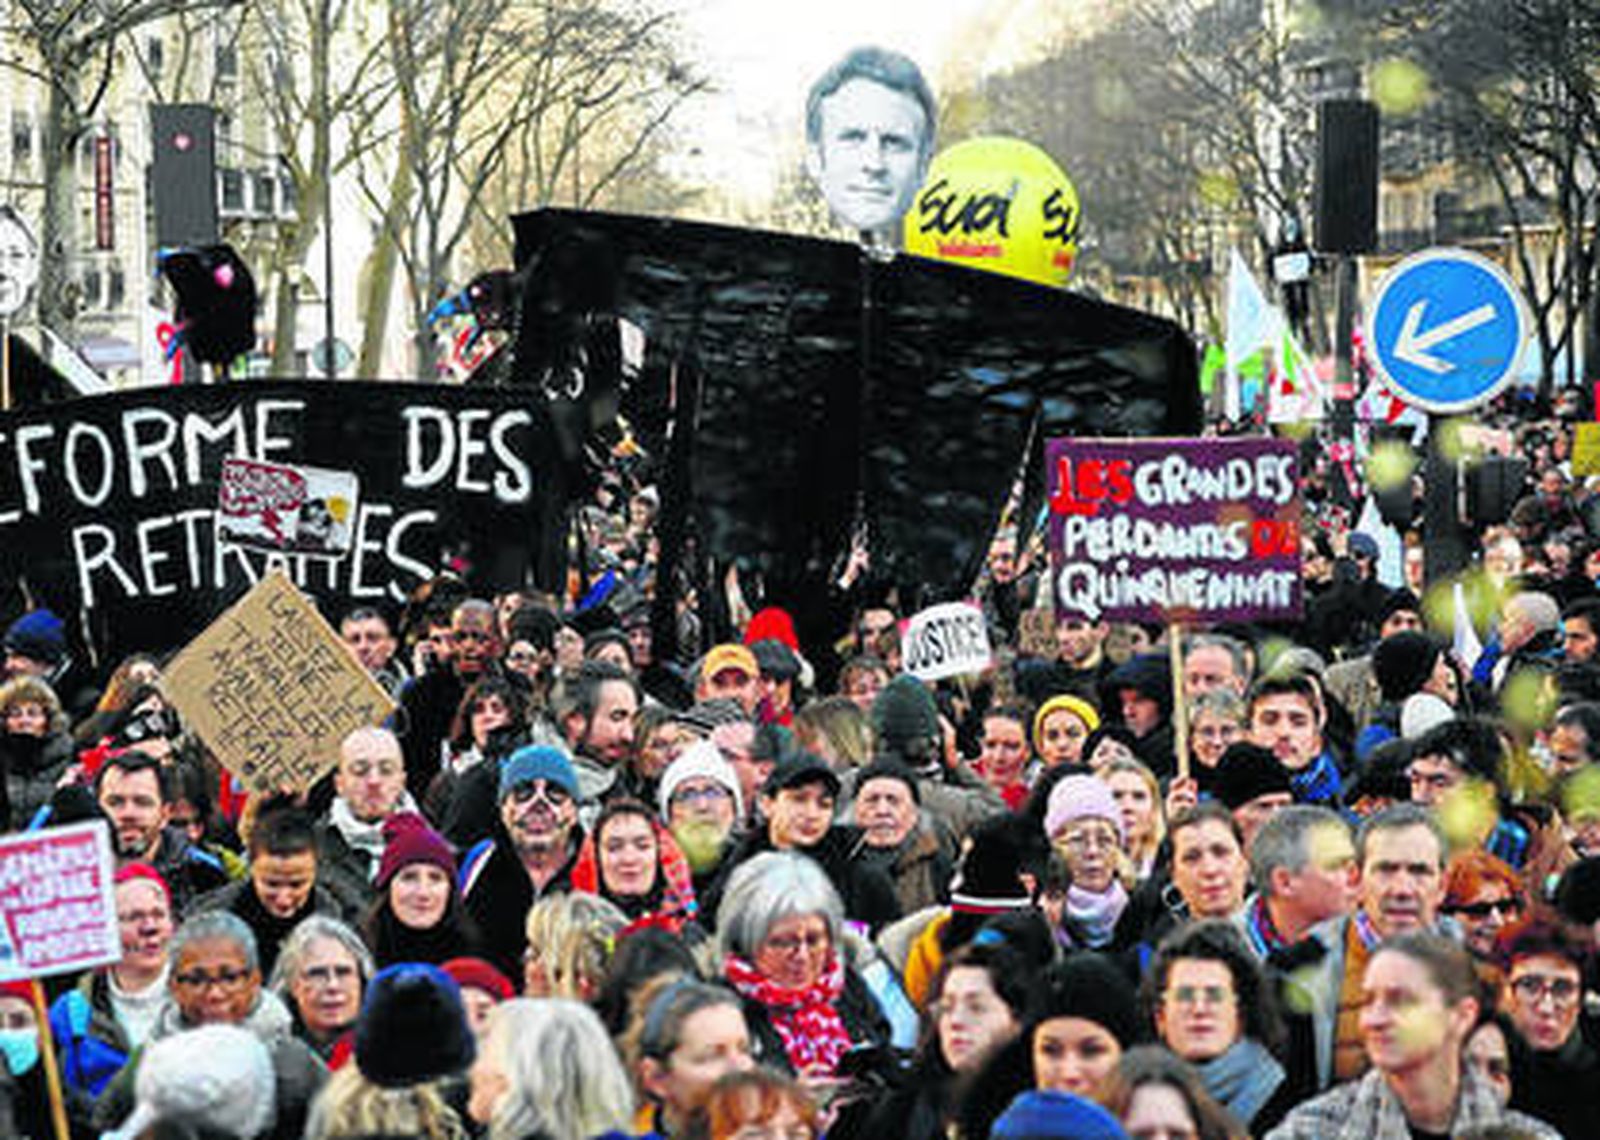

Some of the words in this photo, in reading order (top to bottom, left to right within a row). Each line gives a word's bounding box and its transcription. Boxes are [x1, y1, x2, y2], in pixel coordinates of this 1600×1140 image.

[402, 405, 532, 500] DES
[1051, 456, 1133, 516] LES
[1133, 453, 1294, 506] GRANDES
